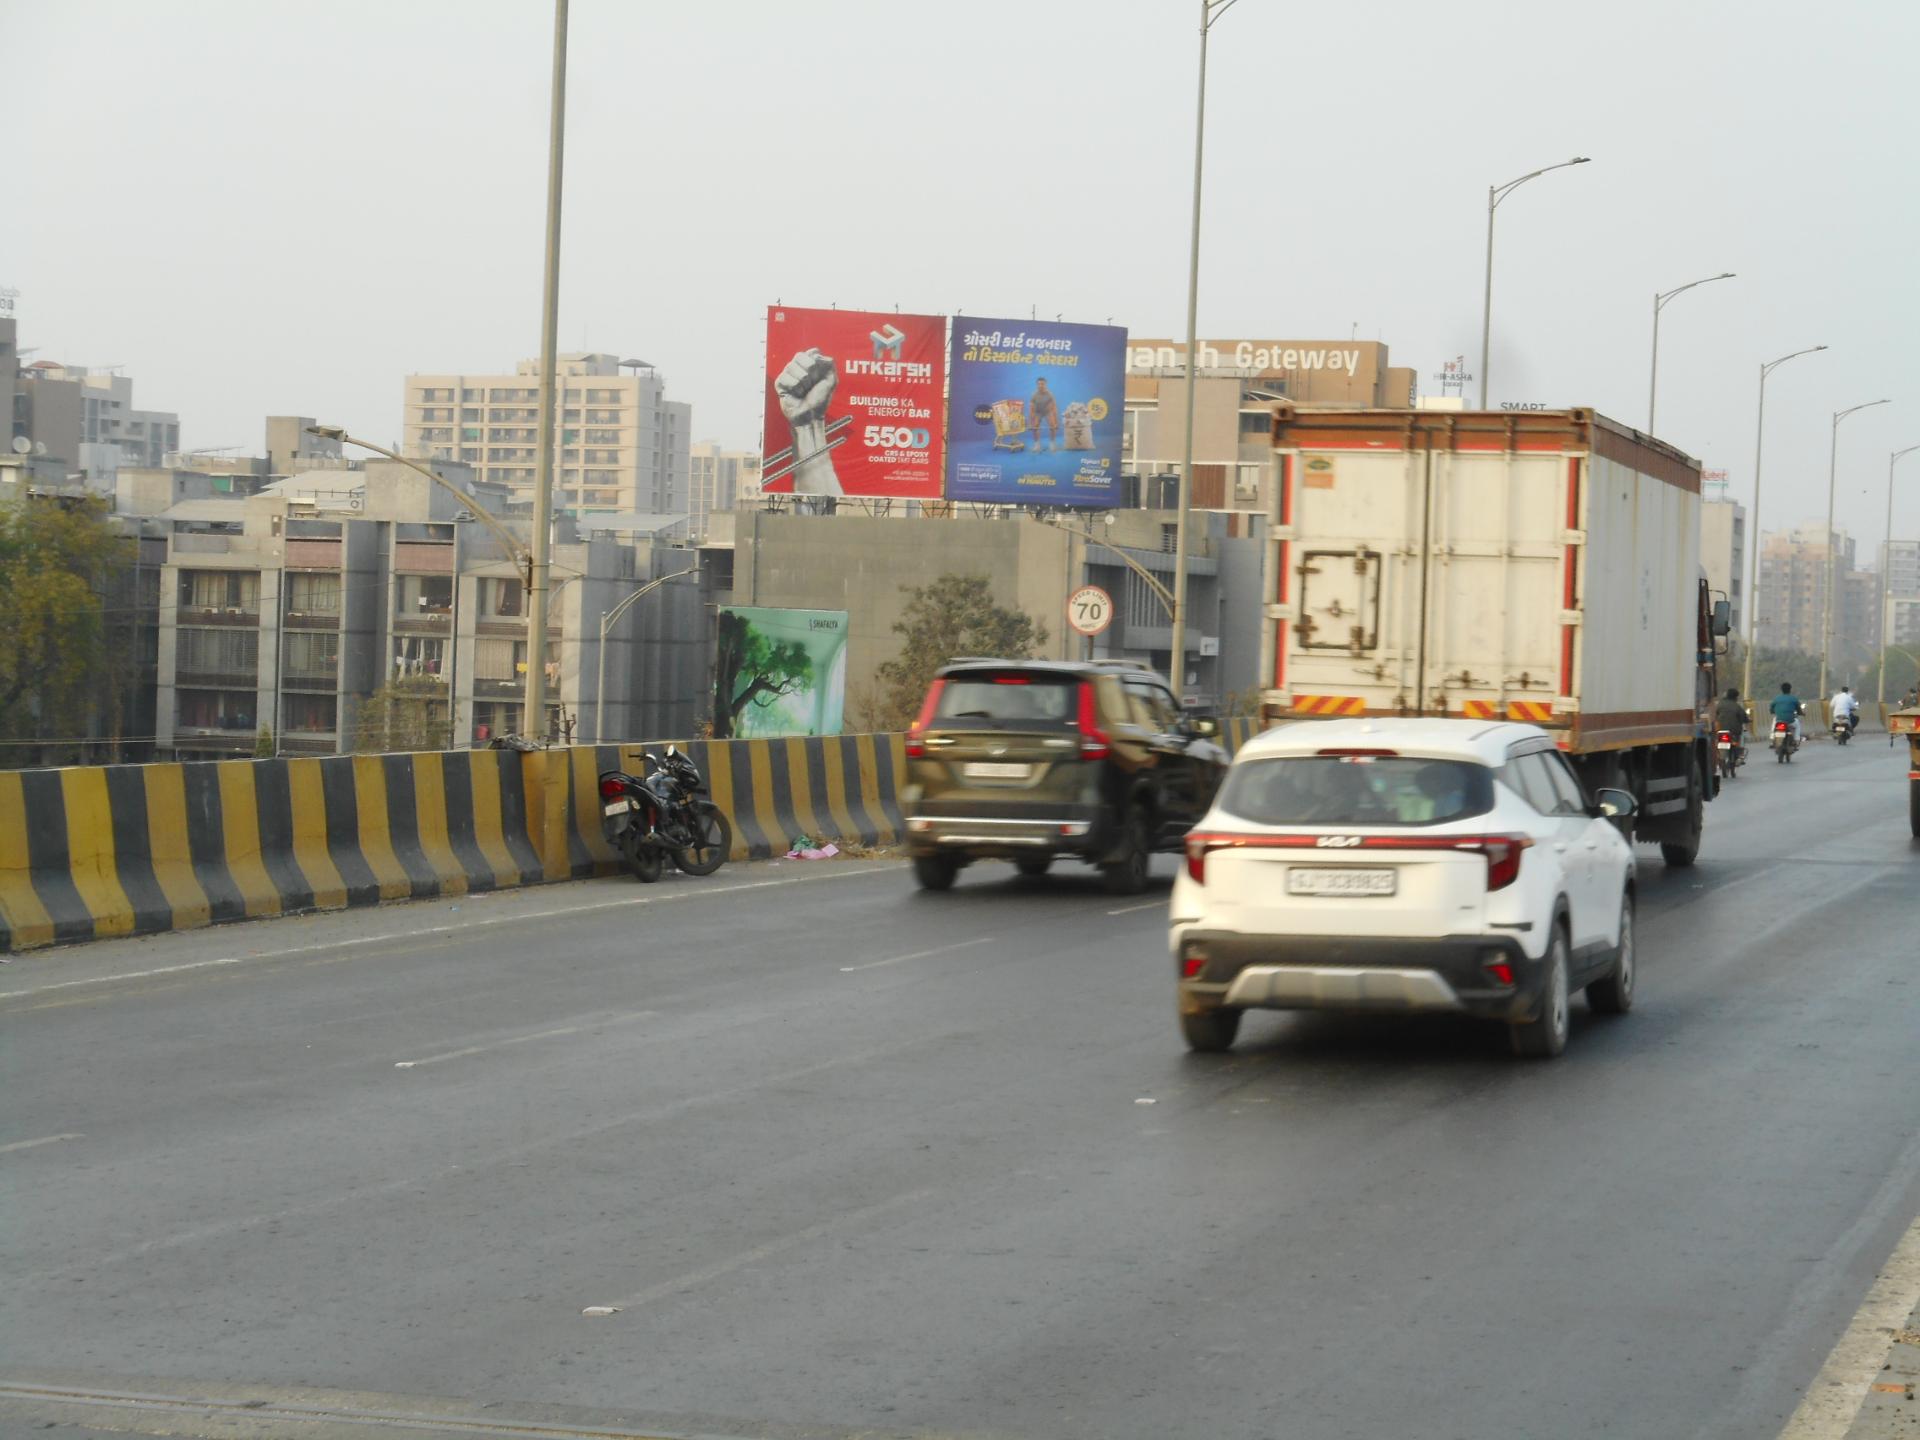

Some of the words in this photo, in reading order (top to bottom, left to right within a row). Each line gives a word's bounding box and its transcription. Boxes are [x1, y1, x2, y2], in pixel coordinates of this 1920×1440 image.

[1002, 332, 1025, 348] કાર્ટ
[1025, 337, 1072, 351] વજનદાર
[963, 346, 977, 361] તો
[1126, 341, 1219, 374] anh
[1235, 341, 1360, 376] Gateway
[849, 395, 899, 407] BUILDING
[901, 398, 914, 407] KA
[1500, 401, 1547, 411] SMART
[868, 406, 907, 417] ENERGY
[908, 408, 931, 419] BAR
[863, 424, 930, 449] 550D
[868, 455, 897, 463] COATED
[1071, 590, 1091, 605] SPEED
[1092, 591, 1108, 606] LIMIT
[1077, 603, 1102, 620] 70
